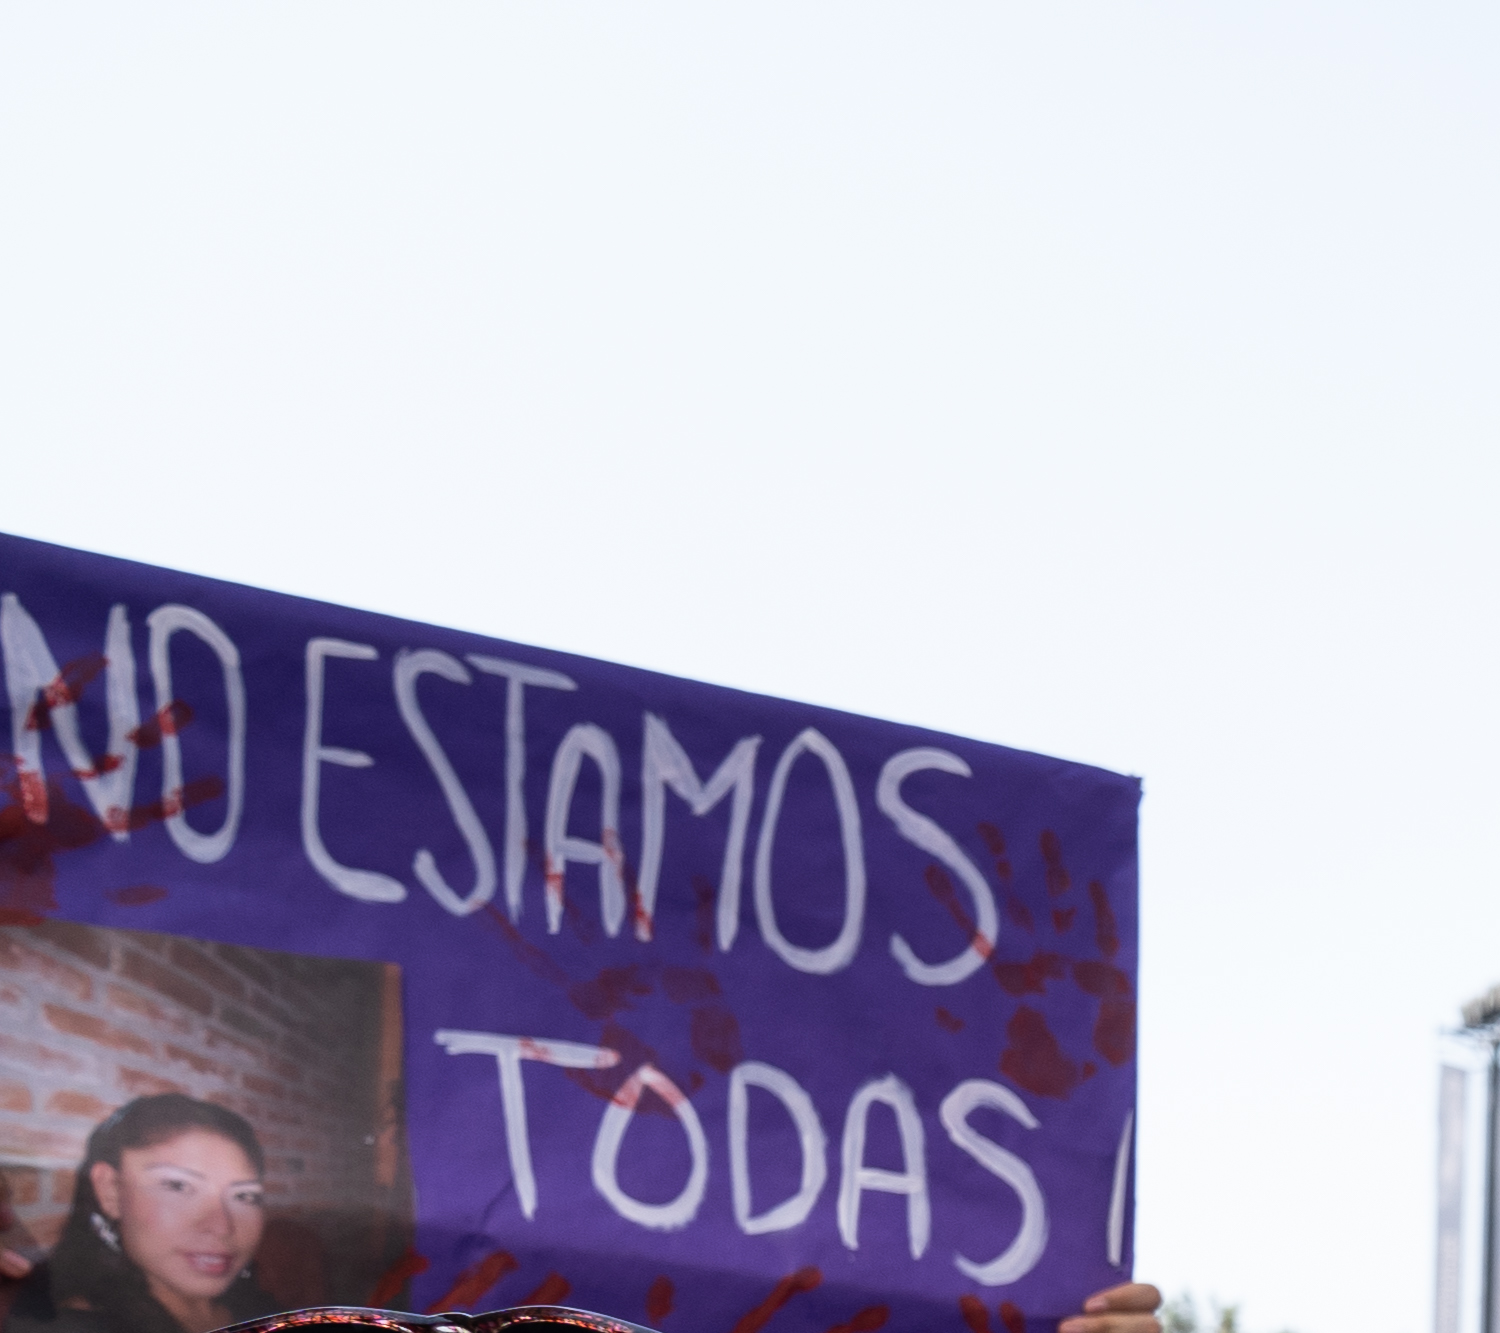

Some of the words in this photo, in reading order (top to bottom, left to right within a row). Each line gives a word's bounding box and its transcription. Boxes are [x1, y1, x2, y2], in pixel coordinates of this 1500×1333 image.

[0, 592, 247, 864] NO
[301, 636, 1000, 987] ESTAMOS
[434, 1029, 1048, 1287] TODAS
